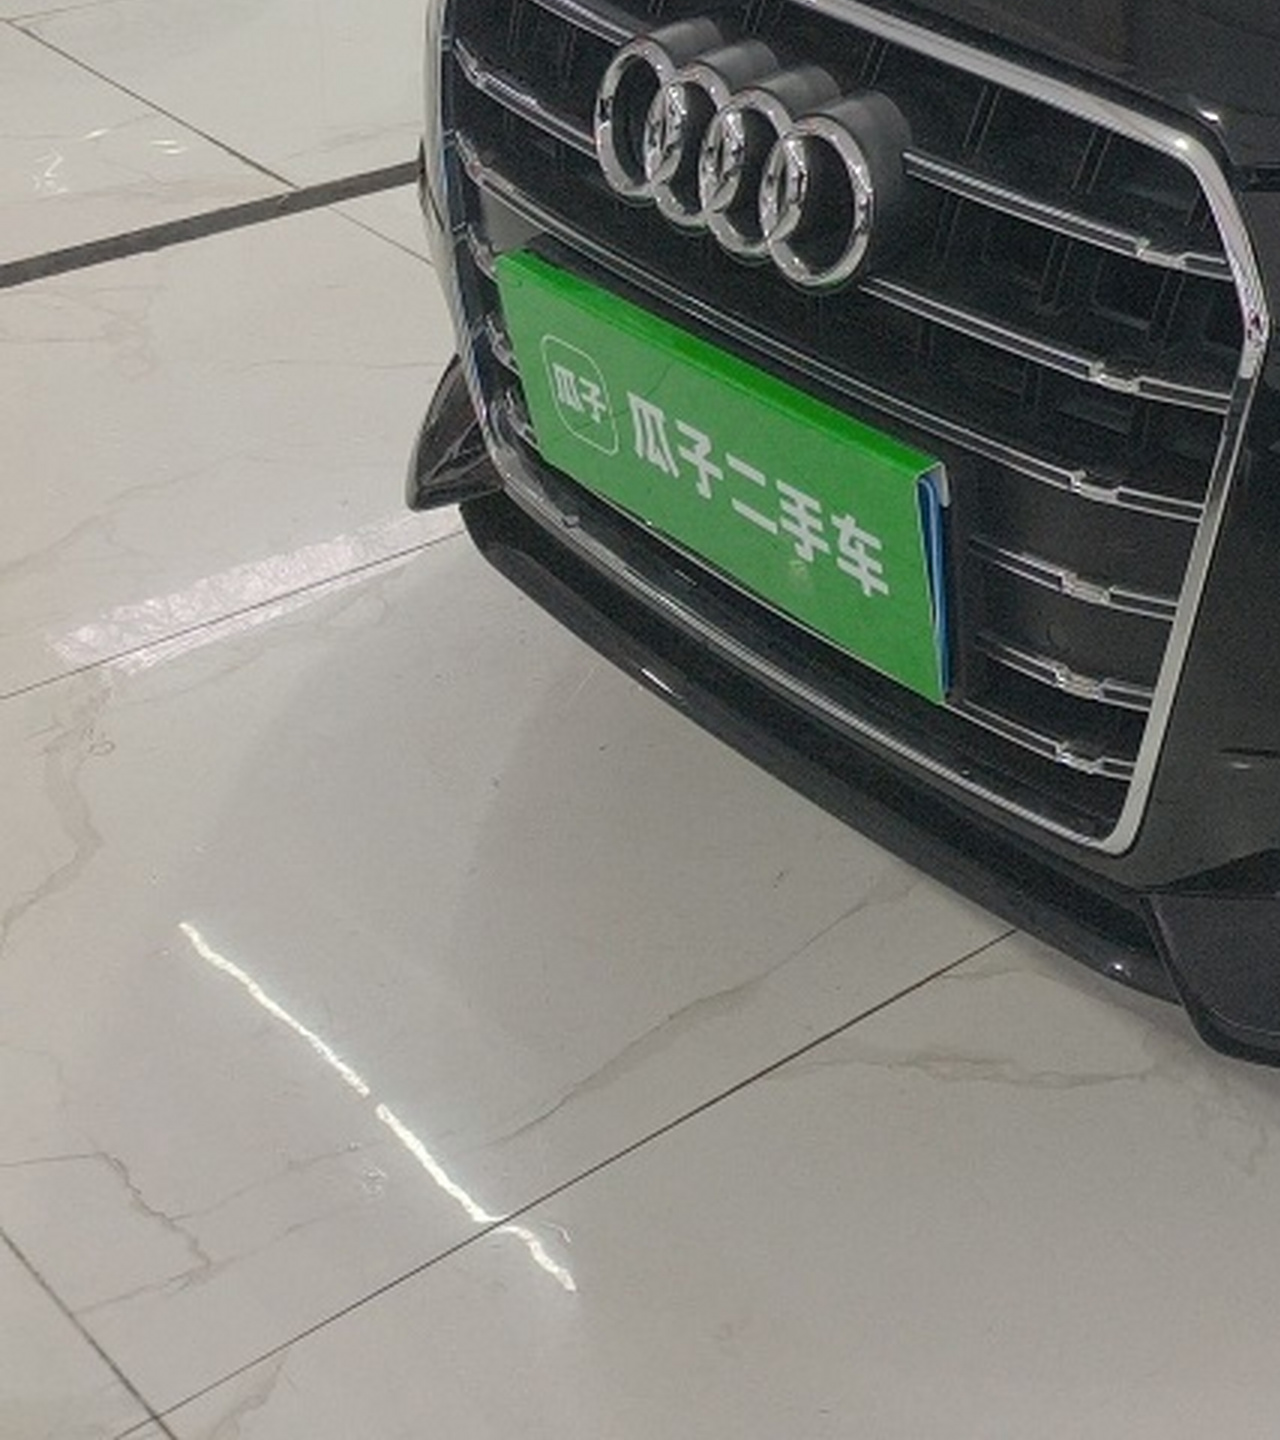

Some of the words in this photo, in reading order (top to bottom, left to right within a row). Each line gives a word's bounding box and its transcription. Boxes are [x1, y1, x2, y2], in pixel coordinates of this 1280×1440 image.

[552, 363, 606, 424] 瓜子
[626, 391, 890, 598] 瓜子二手车
